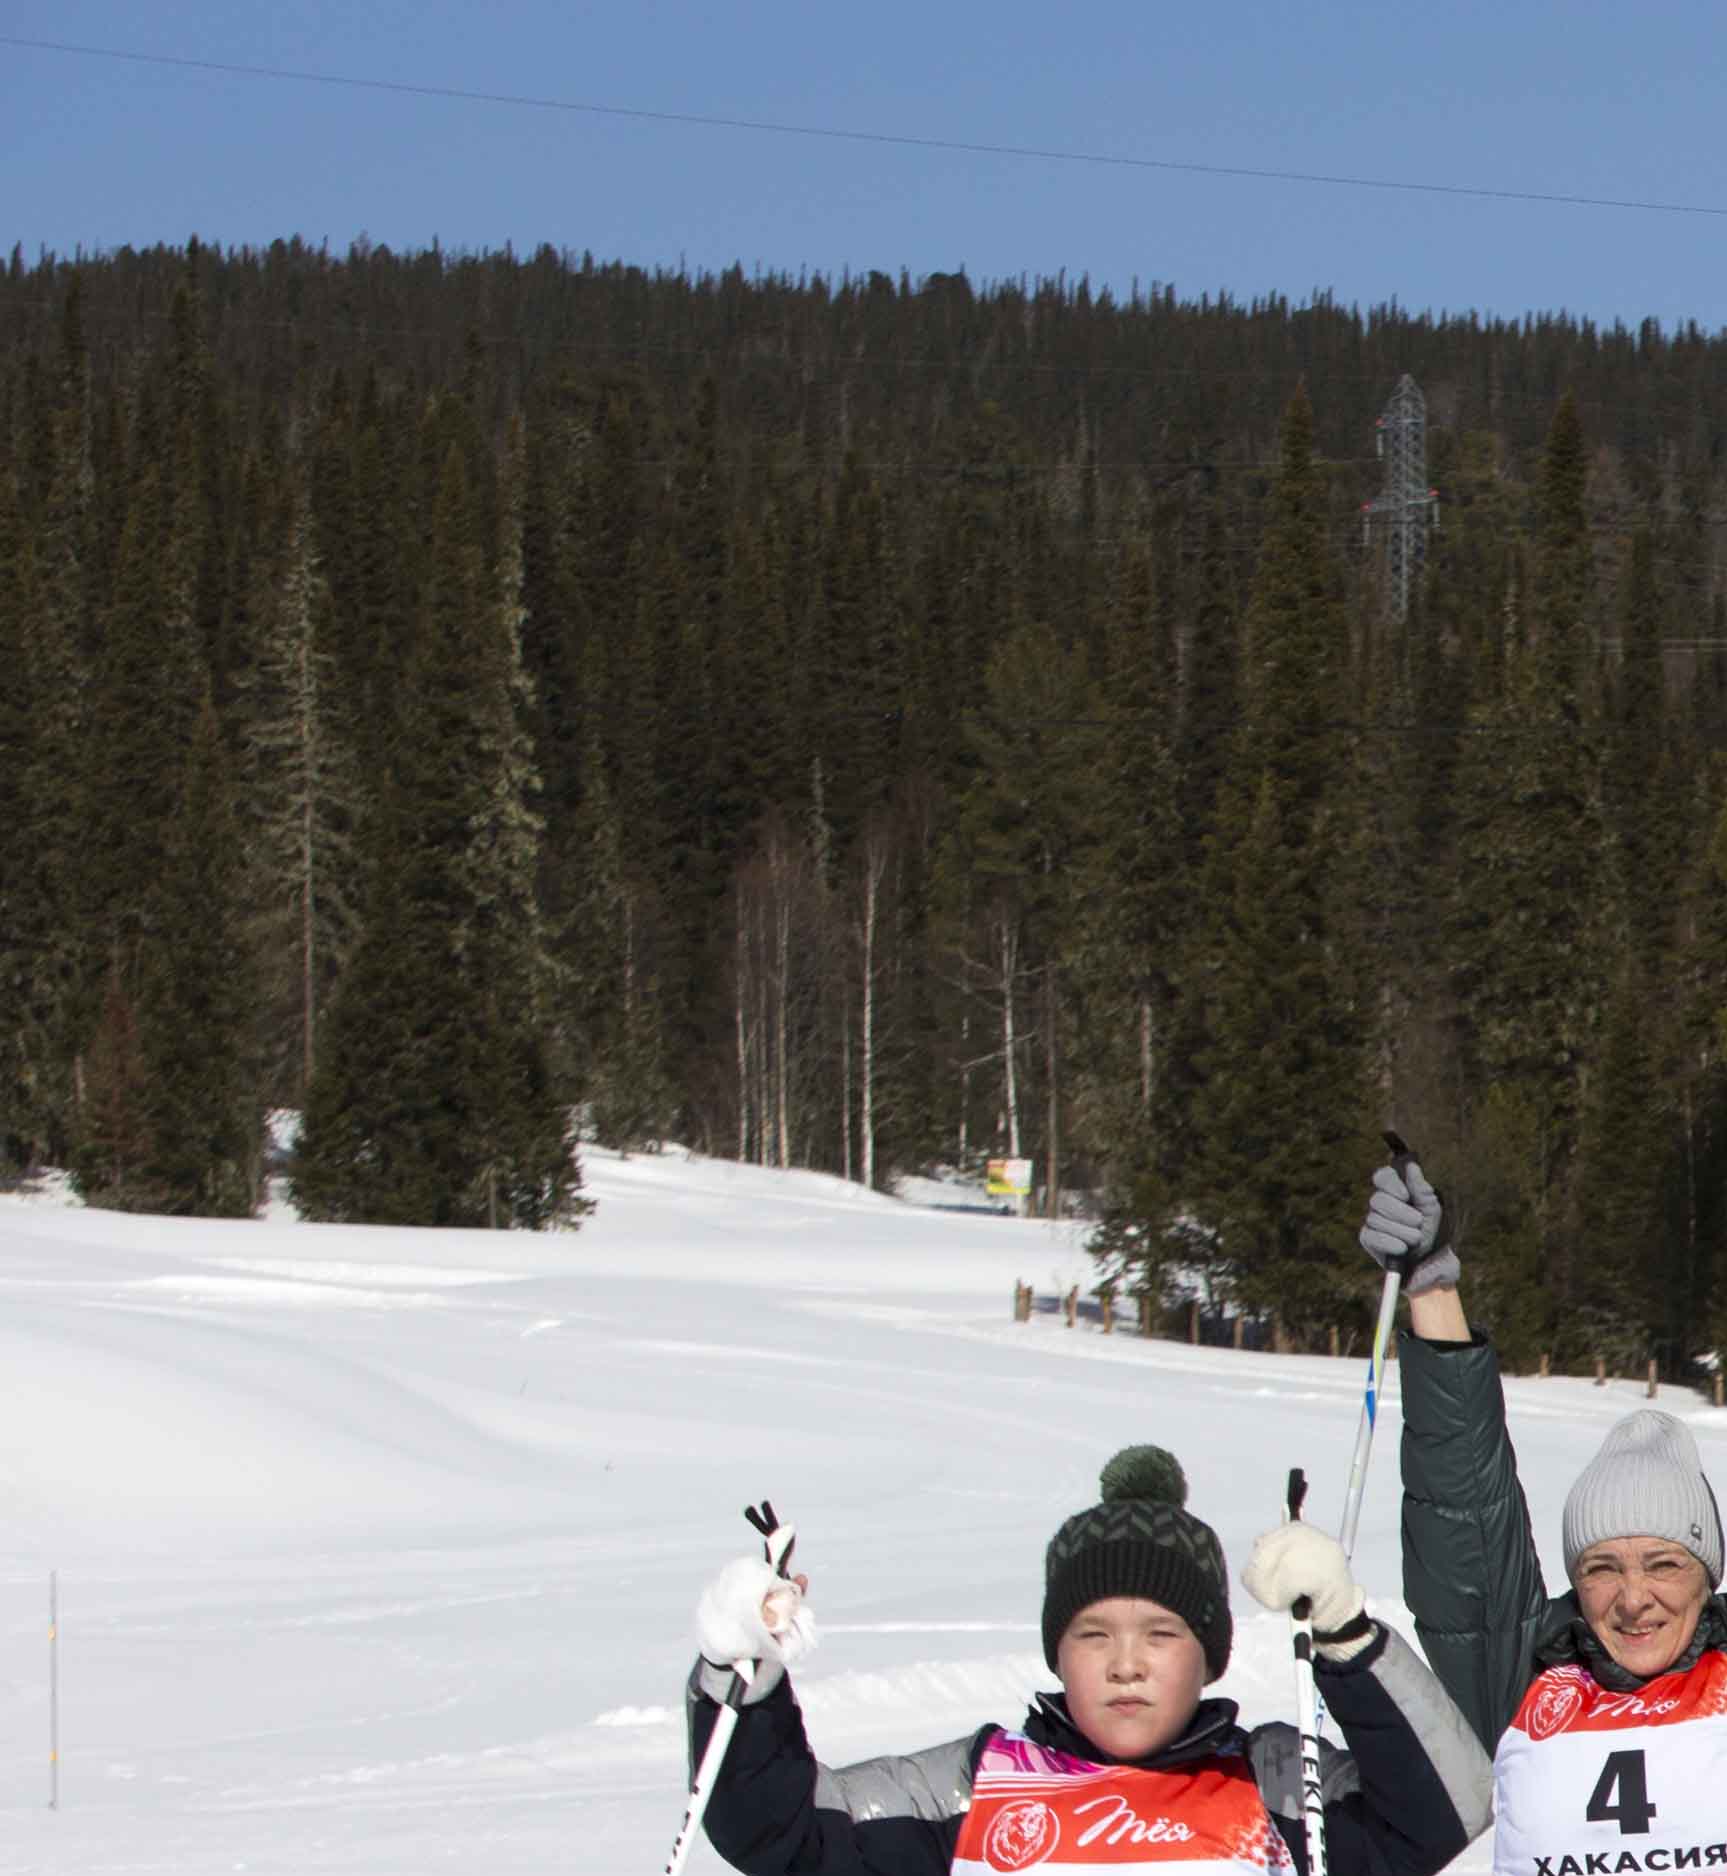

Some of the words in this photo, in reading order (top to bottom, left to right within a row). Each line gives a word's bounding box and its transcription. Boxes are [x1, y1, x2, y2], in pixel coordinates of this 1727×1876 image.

[1301, 1734, 1323, 1814] LEKI
[1586, 1749, 1656, 1835] 4
[1073, 1795, 1195, 1847] Тёя
